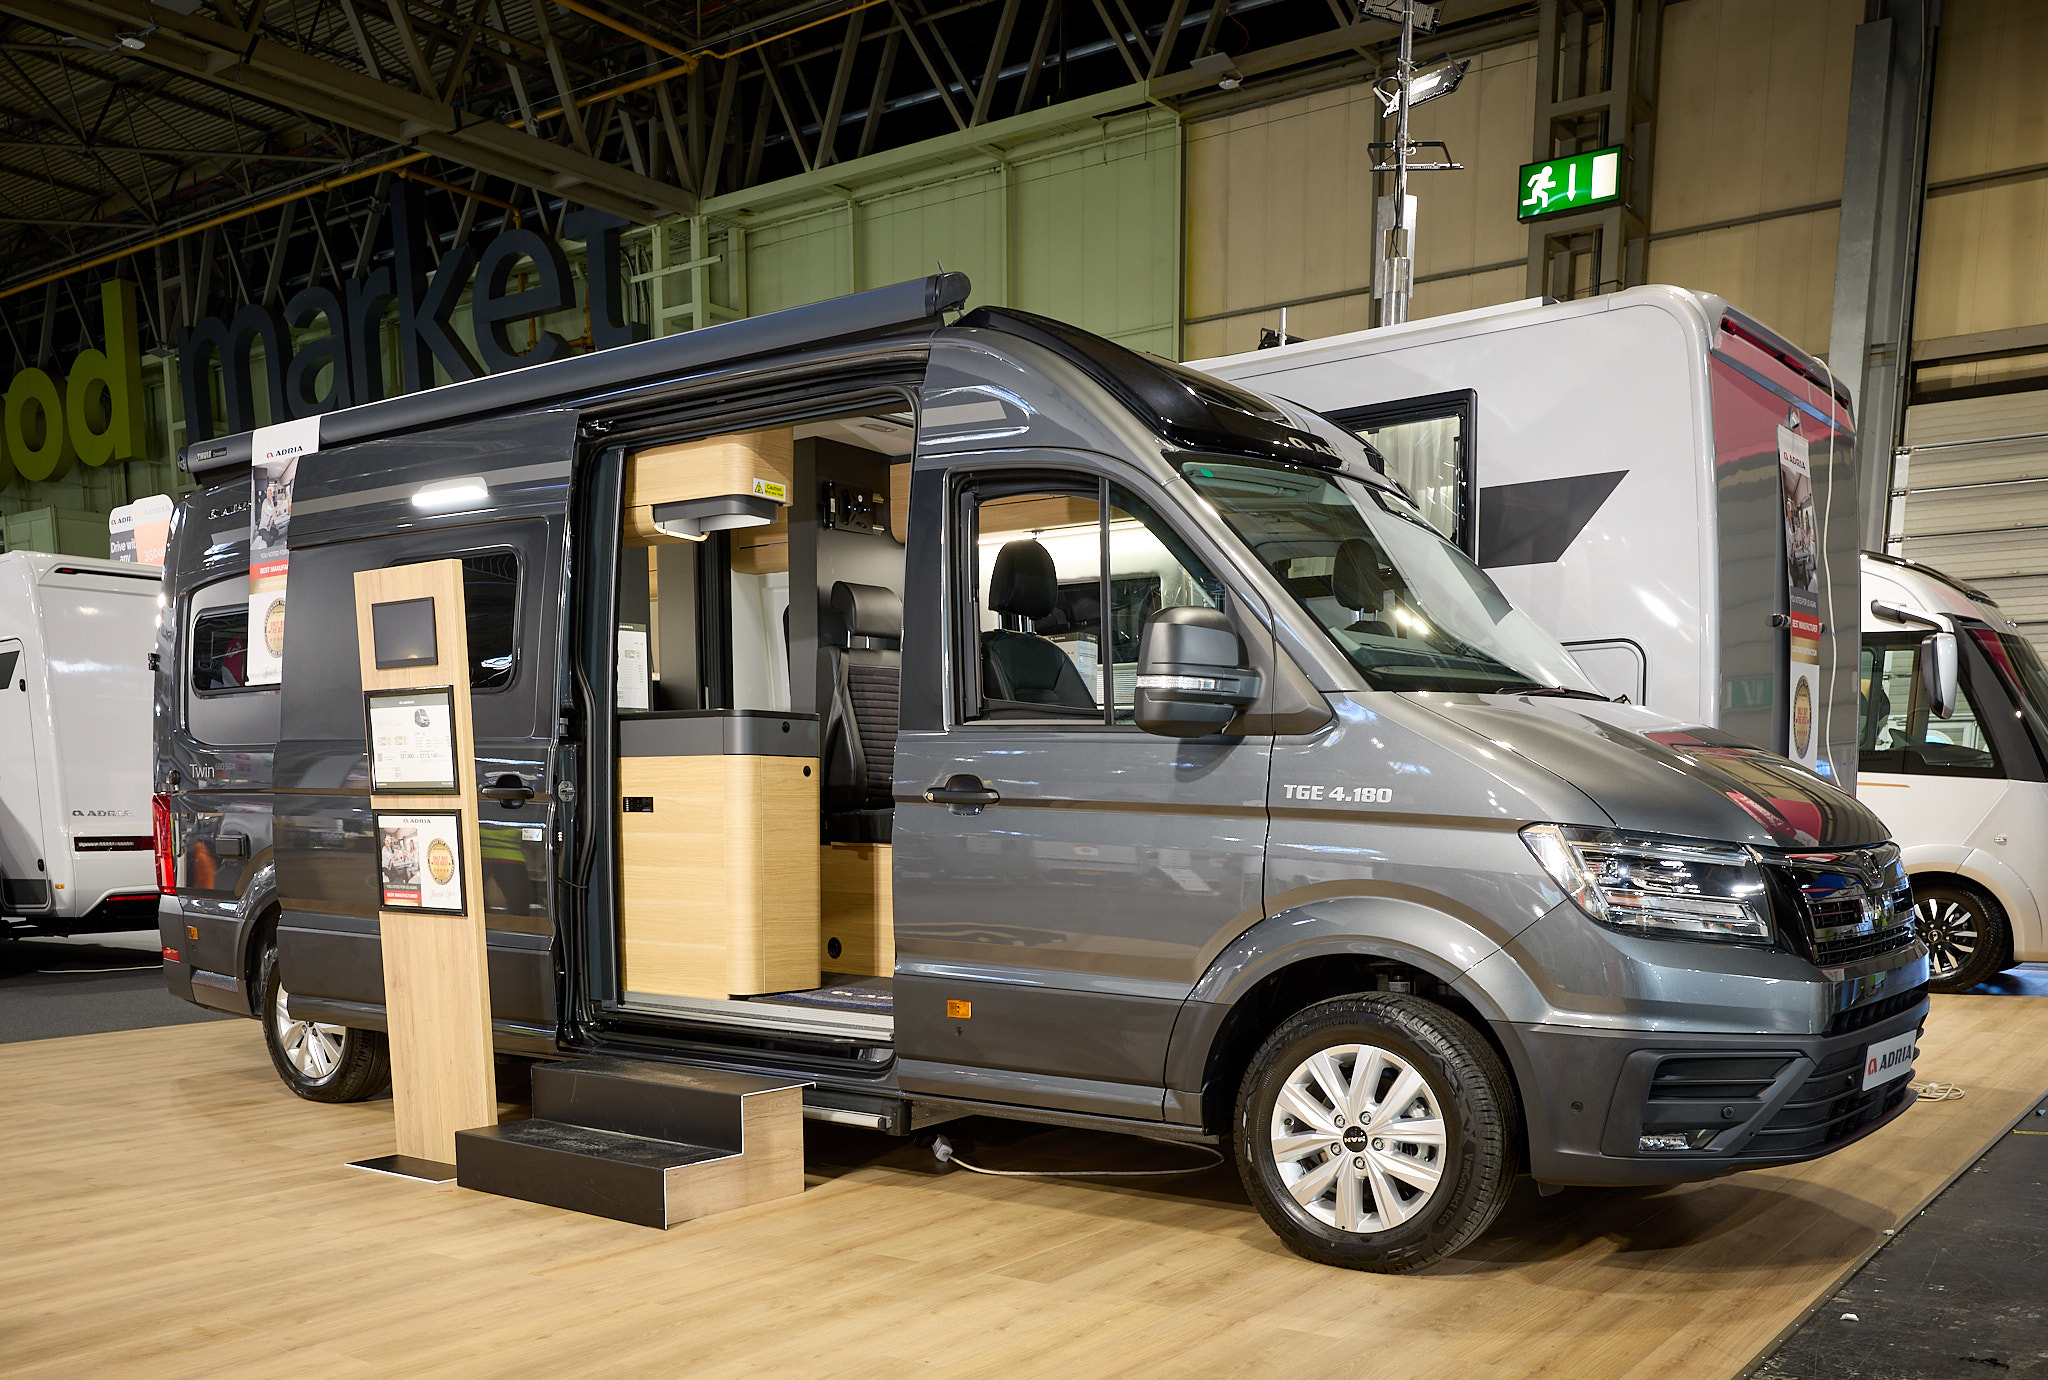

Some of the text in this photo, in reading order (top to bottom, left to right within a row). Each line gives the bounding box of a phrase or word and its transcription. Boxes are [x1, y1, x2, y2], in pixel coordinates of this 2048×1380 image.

[0, 182, 636, 487] od market
[275, 445, 303, 457] ADRIA
[1789, 454, 1806, 470] ADRIA
[111, 538, 137, 553] Drive wit
[189, 763, 215, 778] Twin
[1284, 784, 1393, 803] TGE 4.180
[1879, 1044, 1912, 1071] ADRIA
